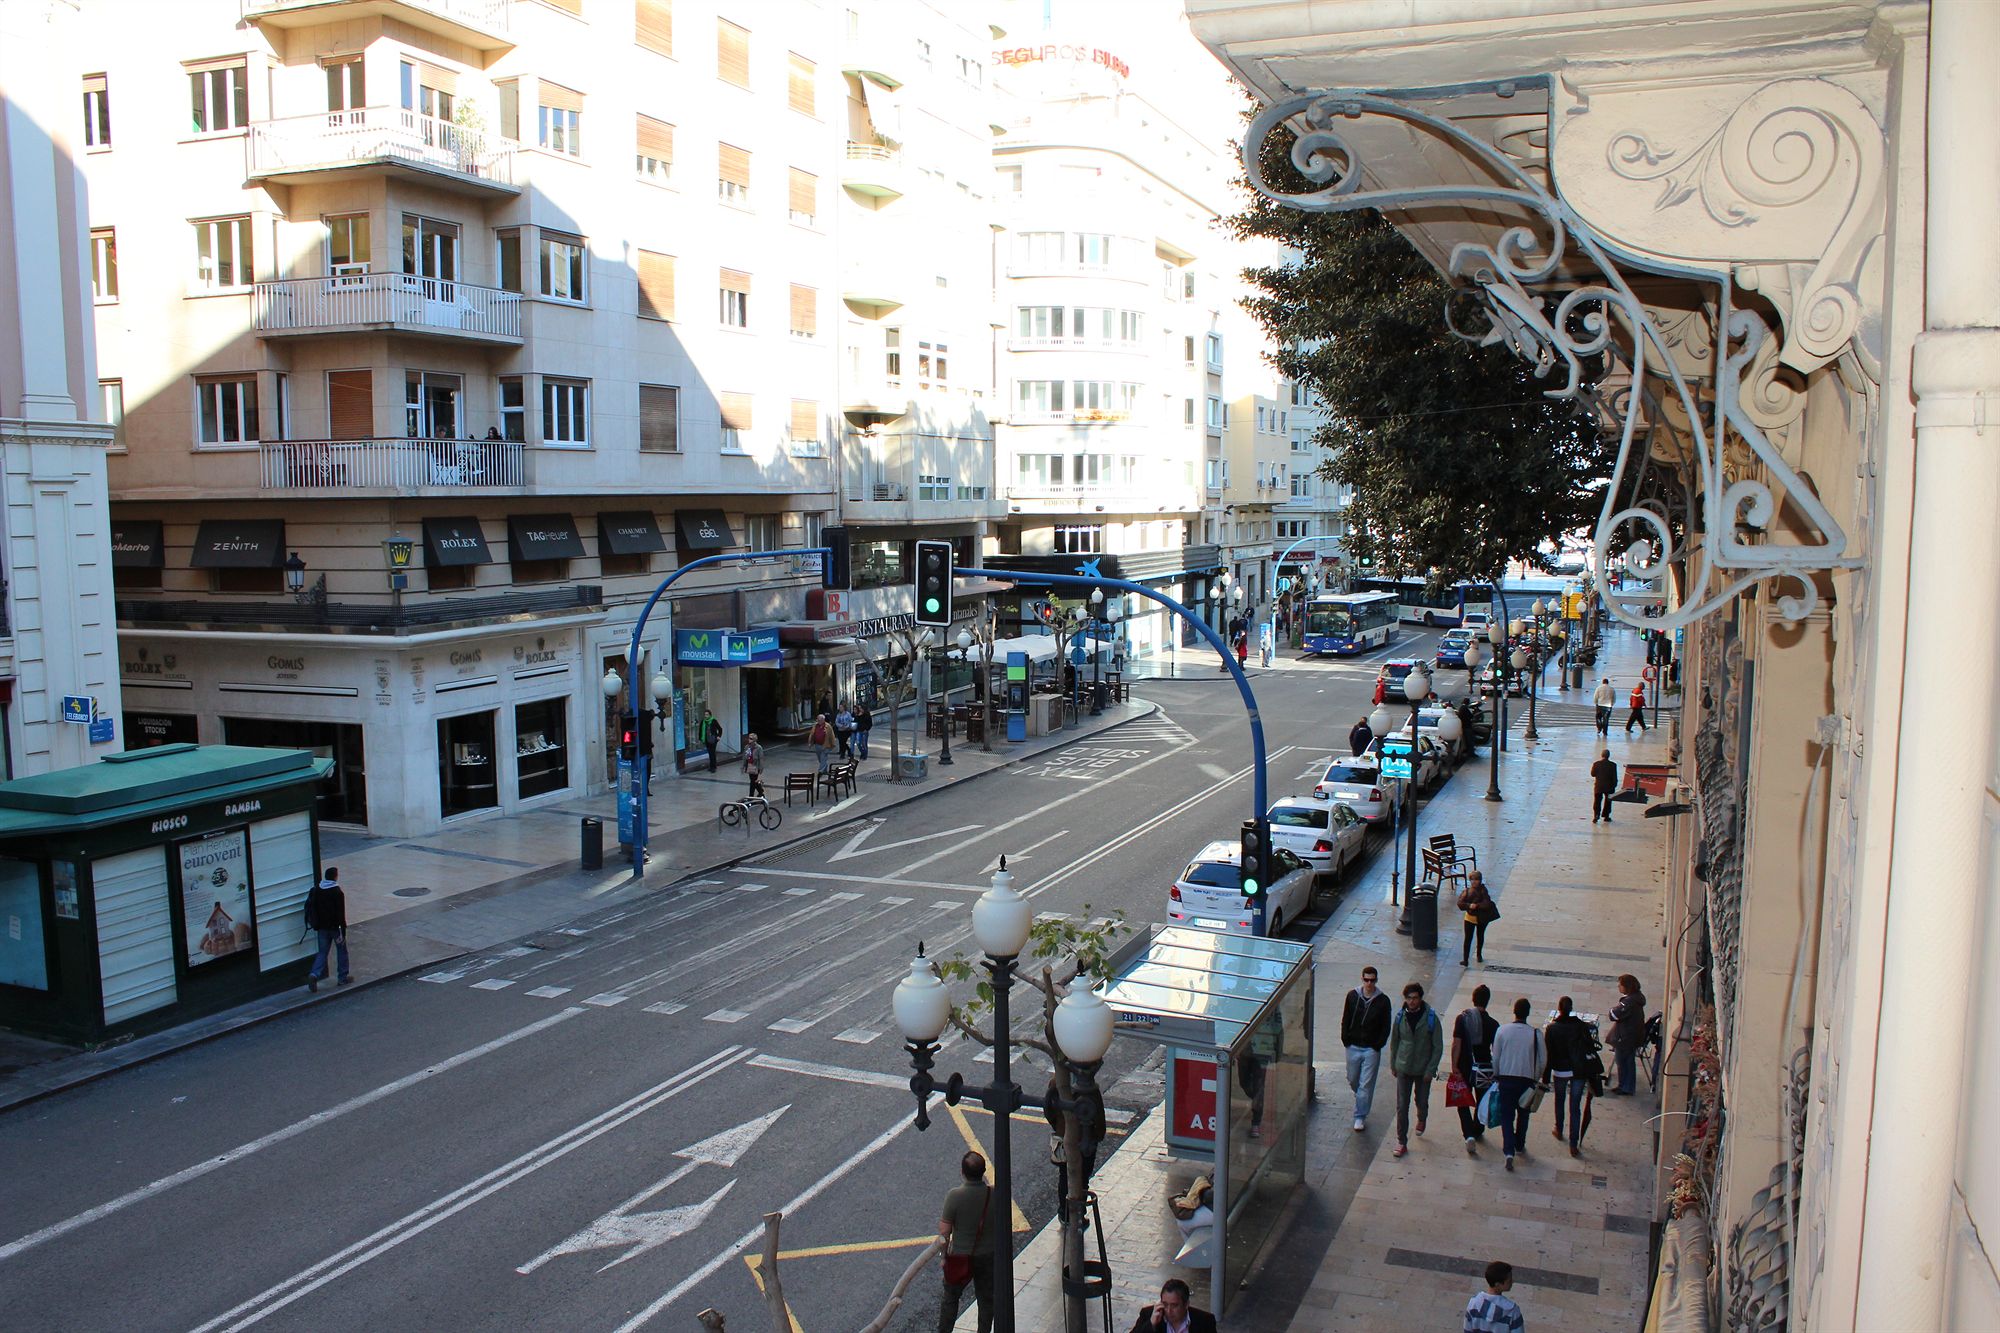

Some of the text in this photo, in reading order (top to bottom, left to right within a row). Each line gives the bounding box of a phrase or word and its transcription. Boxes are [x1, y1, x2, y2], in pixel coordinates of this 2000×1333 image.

[992, 45, 1087, 66] SEGUROS
[618, 527, 648, 535] CHAUMET
[699, 528, 720, 538] EBEL
[212, 542, 260, 551] ZENITH
[440, 538, 478, 549] ROLEX
[857, 612, 919, 638] RESTAURANT
[525, 650, 556, 665] ROLEX
[682, 649, 717, 660] movistar
[125, 662, 162, 674] ROLEX
[145, 726, 167, 735] STOCKS
[151, 800, 261, 833] KIOSCO RAMBLA
[184, 846, 242, 870] eurovent
[1123, 1013, 1132, 1021] 21
[1137, 1015, 1146, 1023] 22
[1190, 1114, 1204, 1130] A
